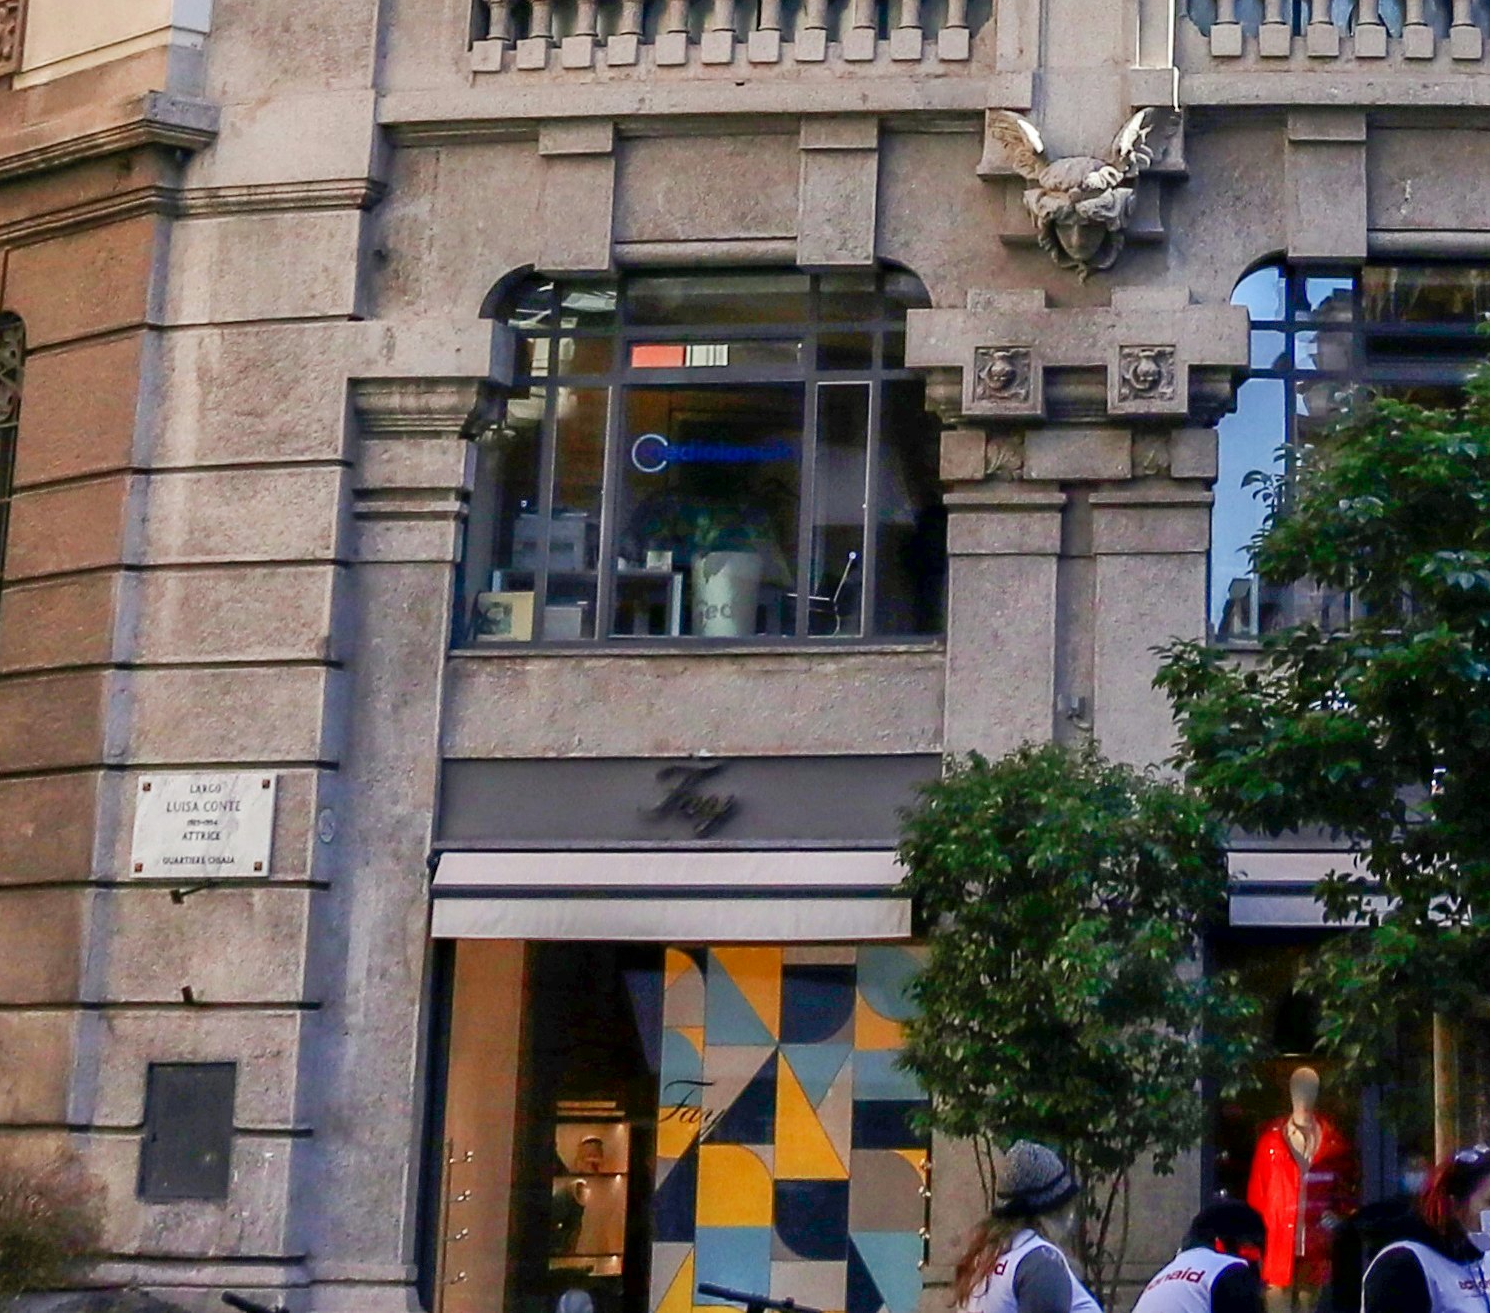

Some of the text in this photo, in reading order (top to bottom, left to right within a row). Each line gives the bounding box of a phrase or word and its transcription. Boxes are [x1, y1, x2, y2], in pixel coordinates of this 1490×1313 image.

[190, 784, 222, 794] LARGO
[166, 800, 241, 813] LUISA CONTE
[181, 830, 221, 841] ATTRICE
[658, 1080, 727, 1138] Fay
